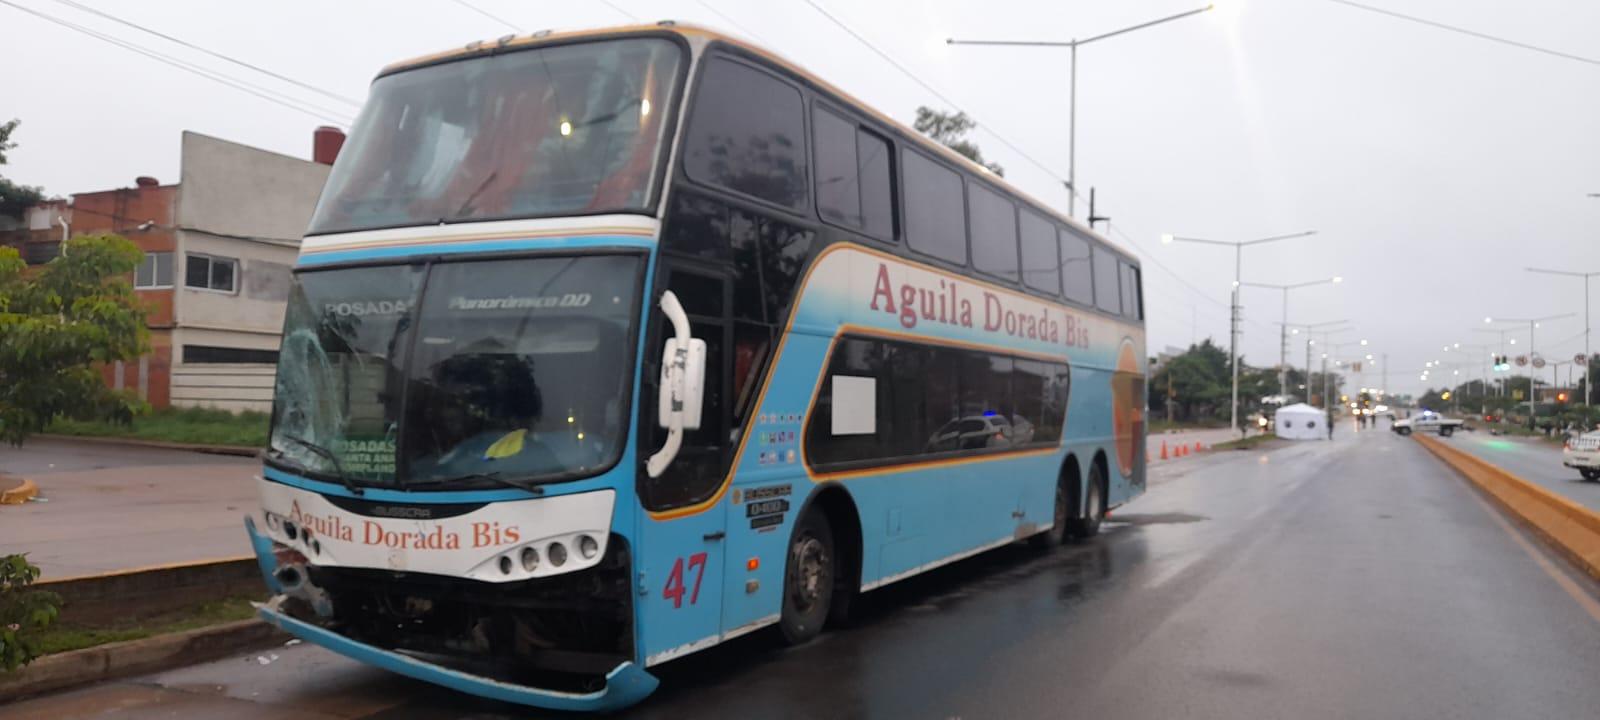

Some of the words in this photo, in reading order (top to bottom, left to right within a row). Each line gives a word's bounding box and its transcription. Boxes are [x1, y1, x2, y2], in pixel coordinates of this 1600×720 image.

[869, 263, 974, 330] Aguila
[983, 291, 1060, 344] Dorada
[1064, 314, 1090, 349] Bis
[287, 499, 353, 543] Aguila
[362, 519, 460, 550] Dorada
[471, 521, 521, 548] Bis
[663, 552, 708, 609] 47
